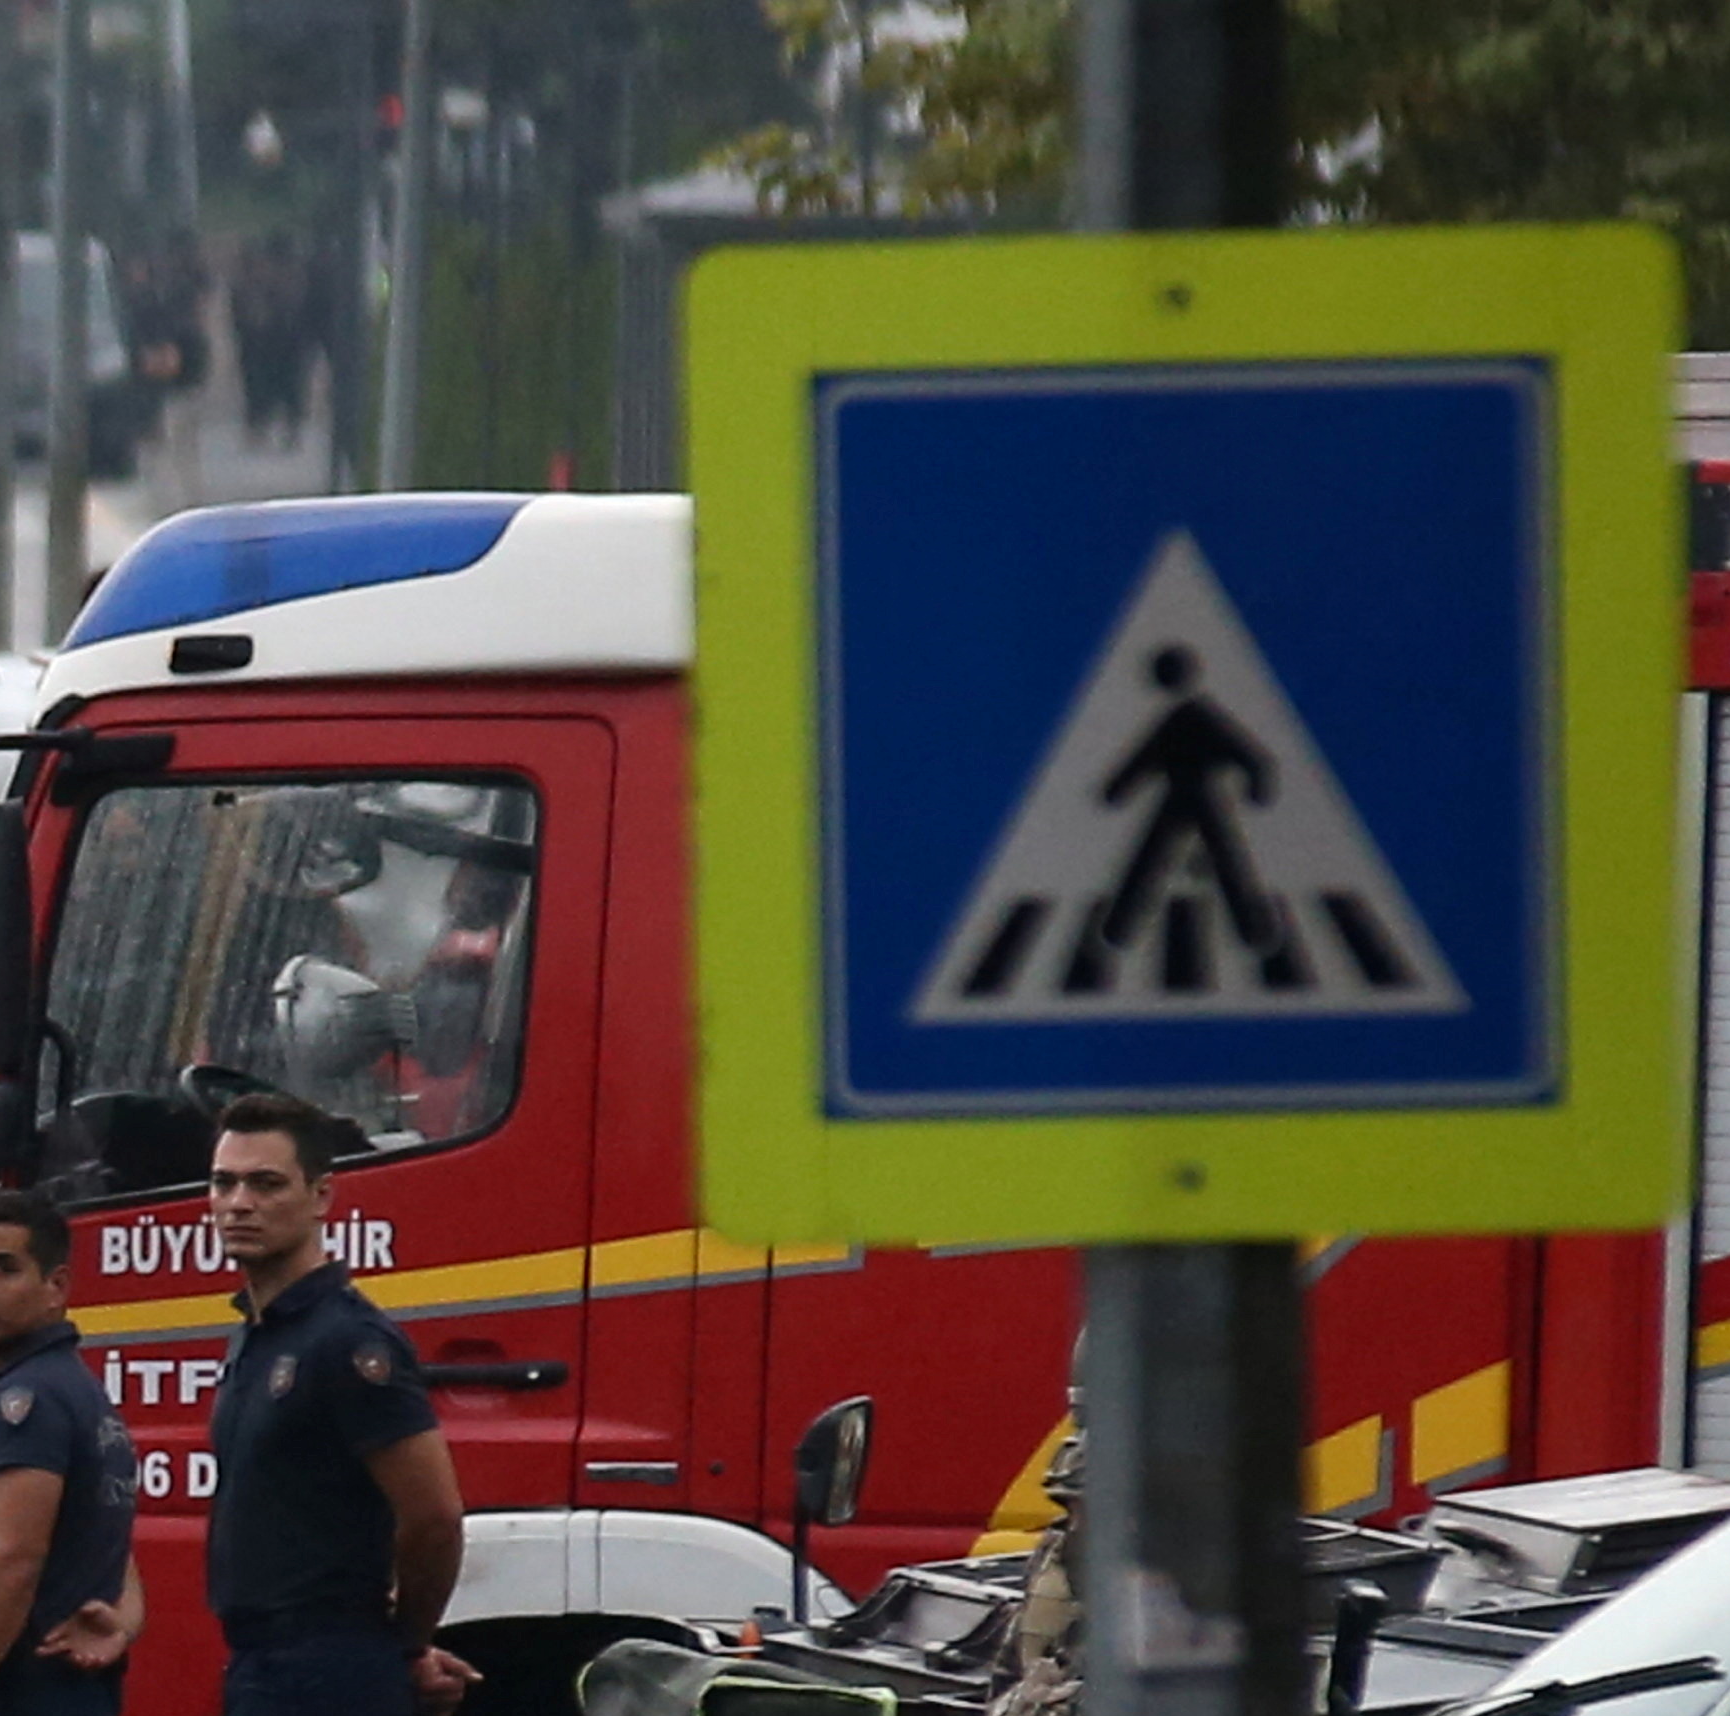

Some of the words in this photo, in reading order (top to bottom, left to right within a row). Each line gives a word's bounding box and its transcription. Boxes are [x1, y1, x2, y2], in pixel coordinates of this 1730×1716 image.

[100, 1208, 396, 1275] BÜYÜHİR
[134, 1451, 171, 1498] 6
[186, 1451, 220, 1498] D
